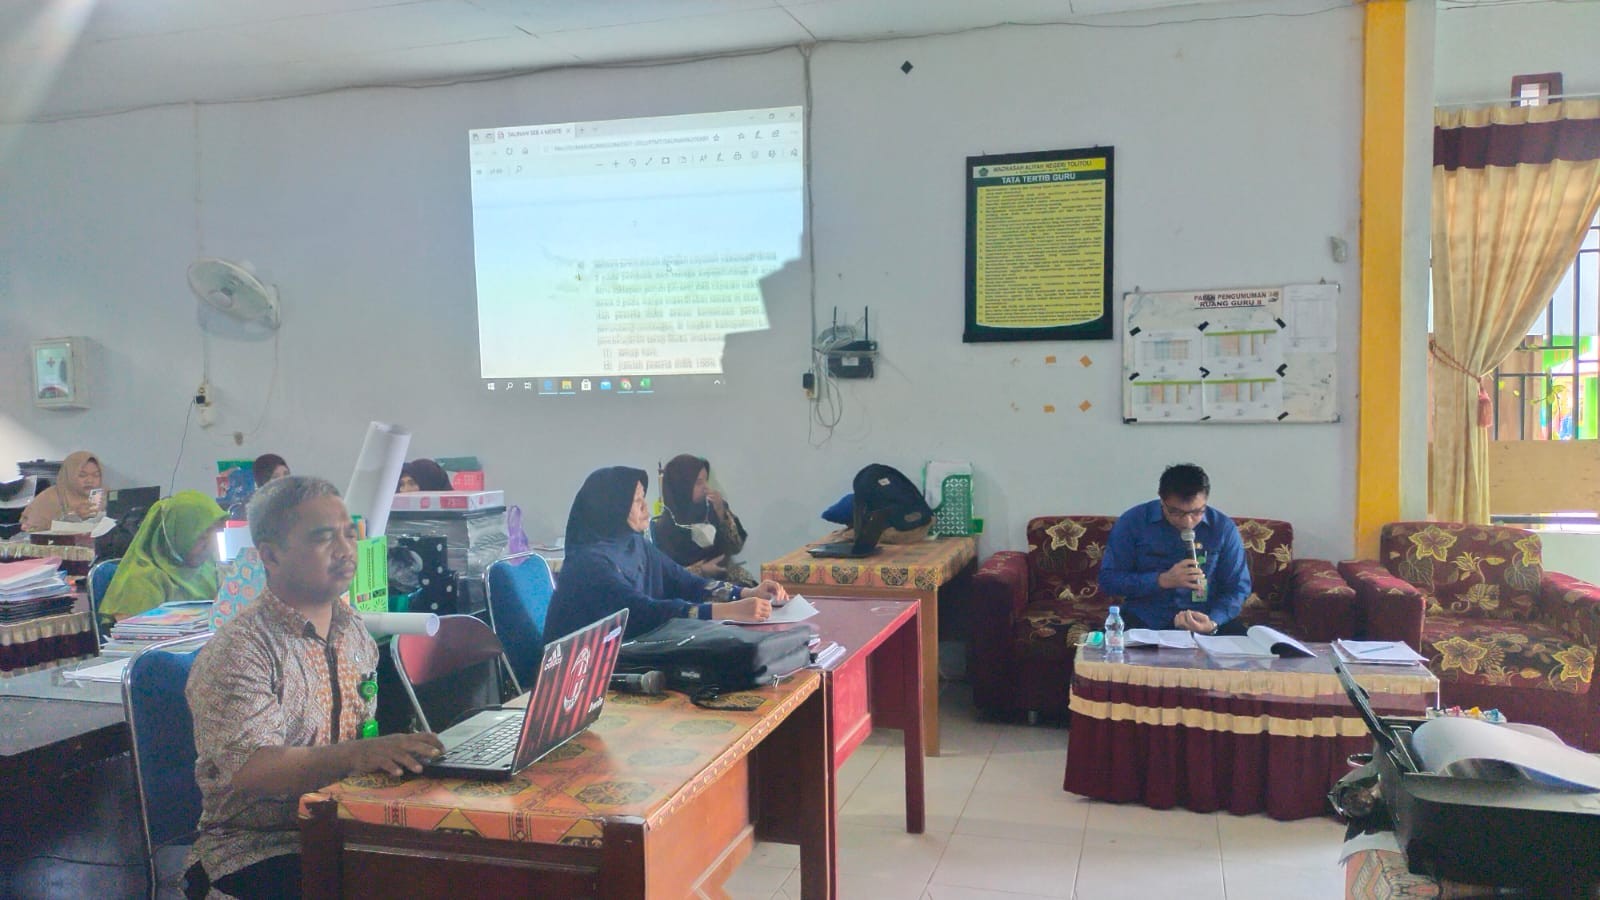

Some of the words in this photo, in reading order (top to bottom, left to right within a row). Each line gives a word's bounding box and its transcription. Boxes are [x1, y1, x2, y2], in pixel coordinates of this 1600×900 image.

[993, 164, 1022, 172] MADRASAH
[1046, 160, 1066, 169] NEGERI
[1068, 159, 1092, 167] TOLITOLI
[1001, 175, 1020, 184] TATA
[1022, 173, 1050, 183] TERTIB
[1052, 172, 1076, 181] GURU
[1217, 291, 1267, 300] PENGUMUMAN
